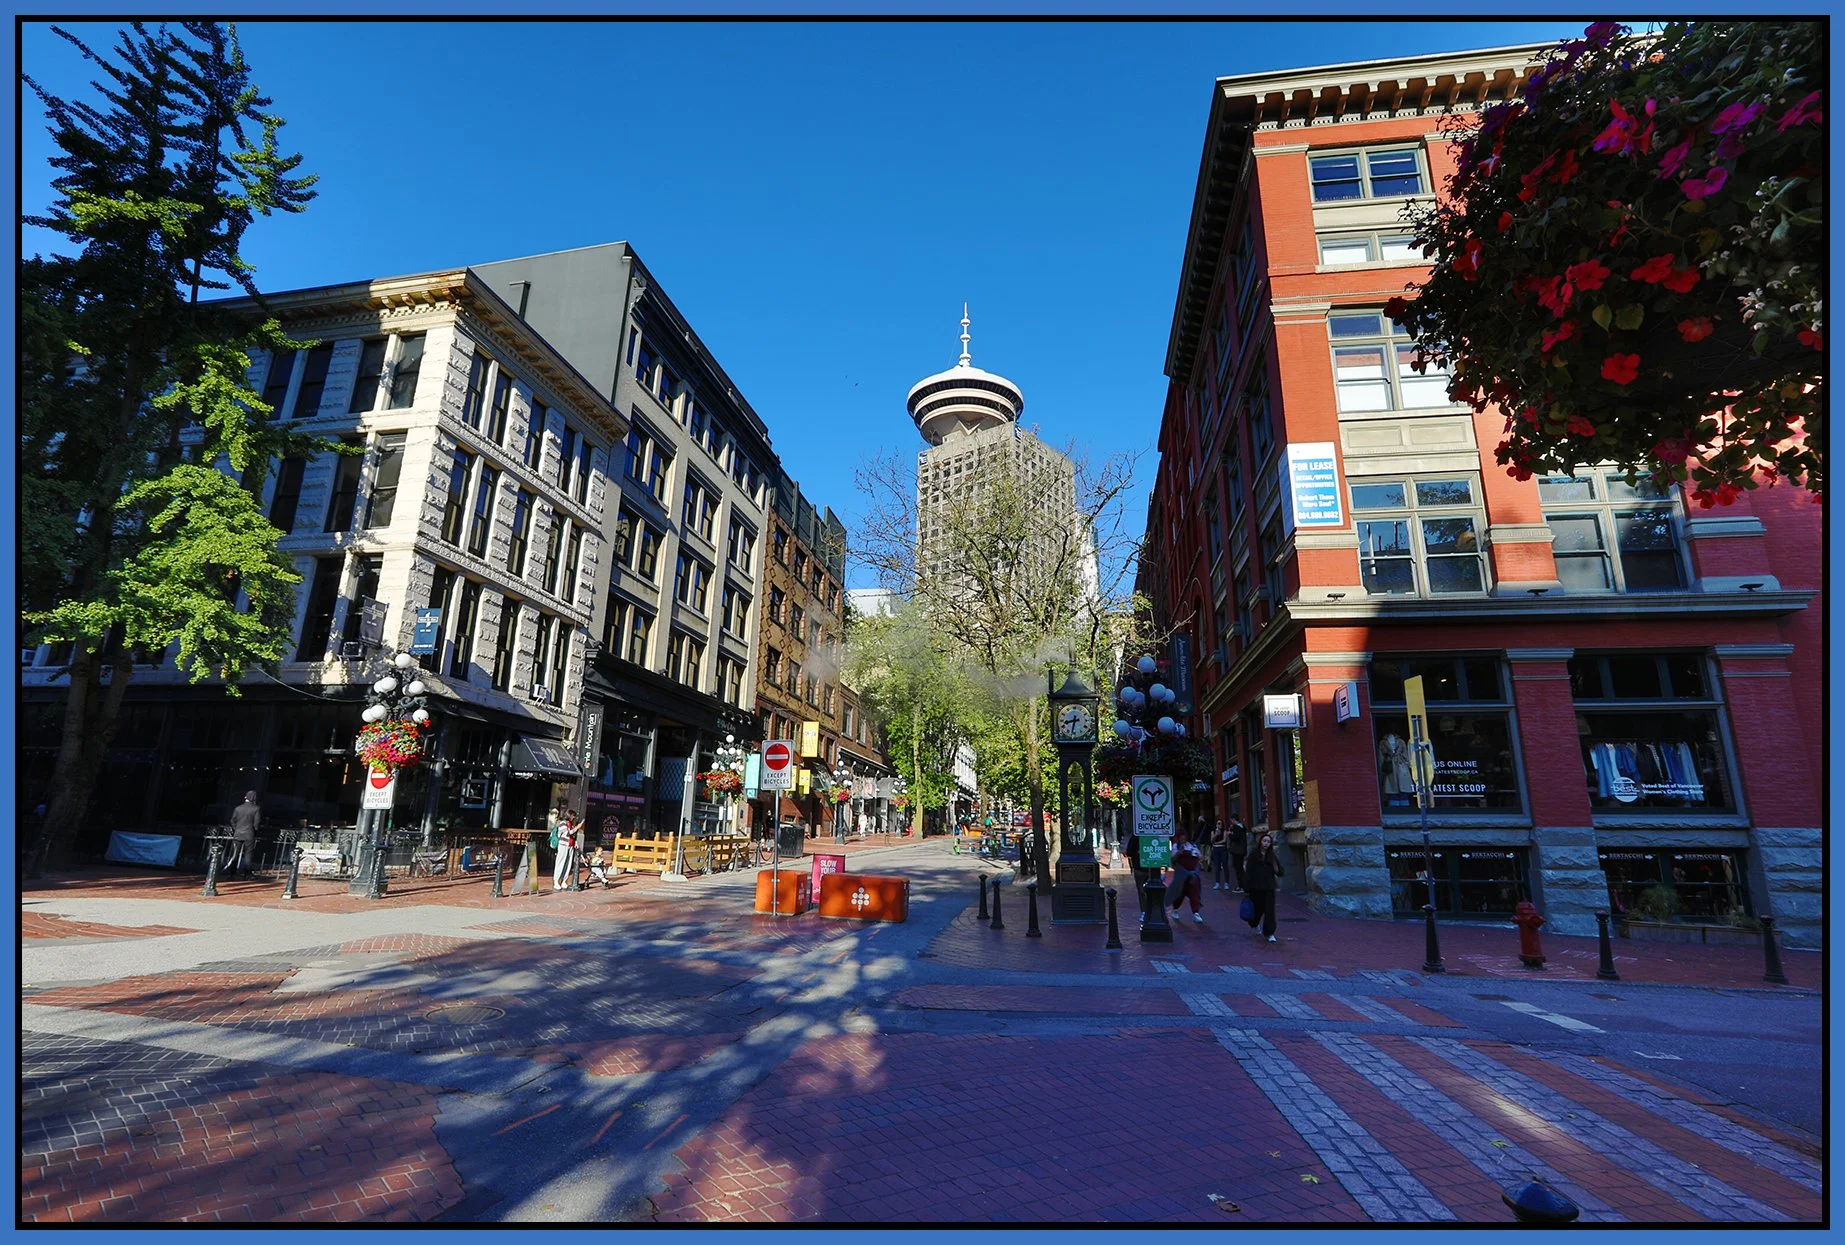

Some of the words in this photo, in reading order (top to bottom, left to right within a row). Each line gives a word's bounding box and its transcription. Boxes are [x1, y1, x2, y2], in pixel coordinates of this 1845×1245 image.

[1292, 462, 1308, 471] FOR
[1310, 461, 1334, 470] LEASE
[585, 713, 596, 750] Mountain
[1446, 760, 1478, 768] ONLINE
[1458, 784, 1487, 792] SCOOP
[1138, 822, 1170, 830] BICYCLES
[820, 859, 837, 867] SLOW
